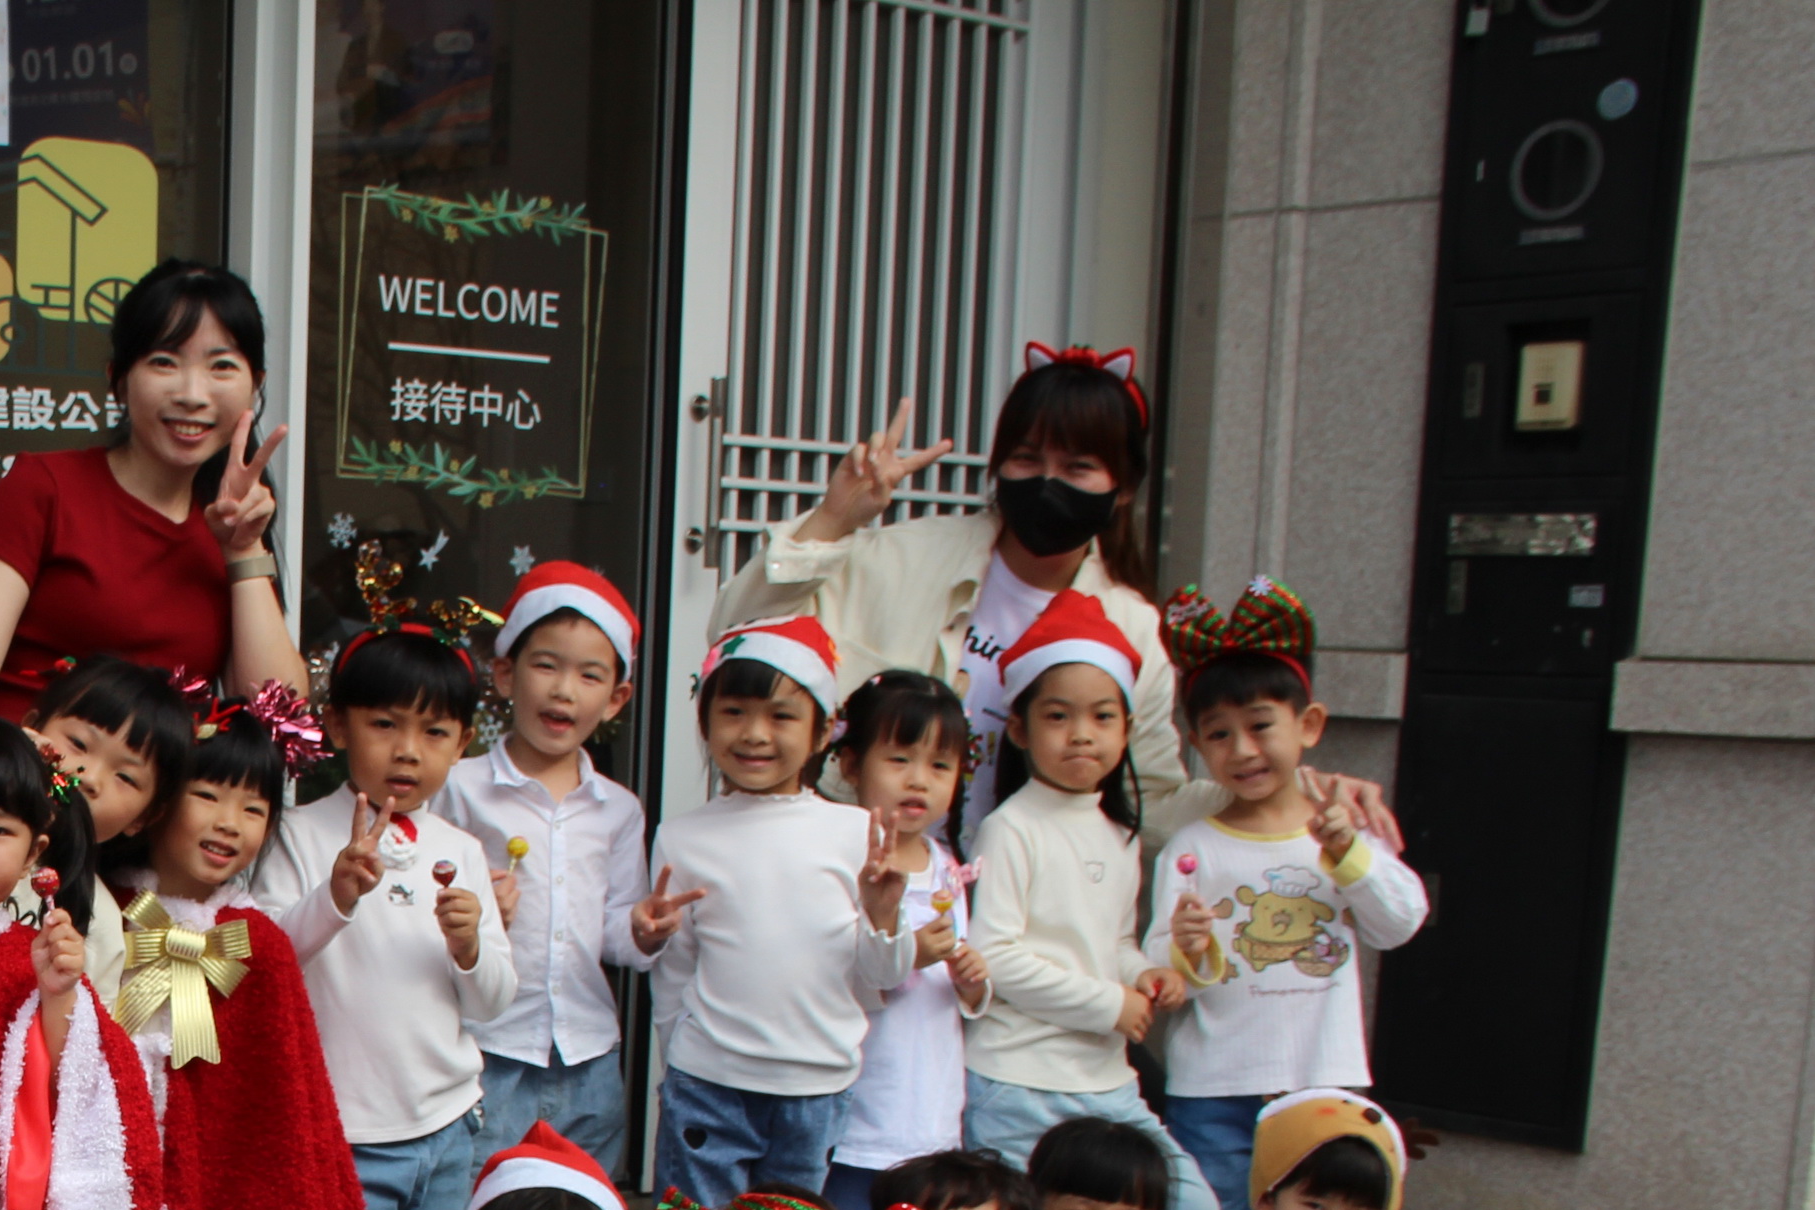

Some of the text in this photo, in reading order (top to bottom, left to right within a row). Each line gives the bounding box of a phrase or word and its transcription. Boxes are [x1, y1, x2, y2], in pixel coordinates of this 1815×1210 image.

[378, 273, 561, 328] WELCOME
[390, 376, 542, 431] 接待中心
